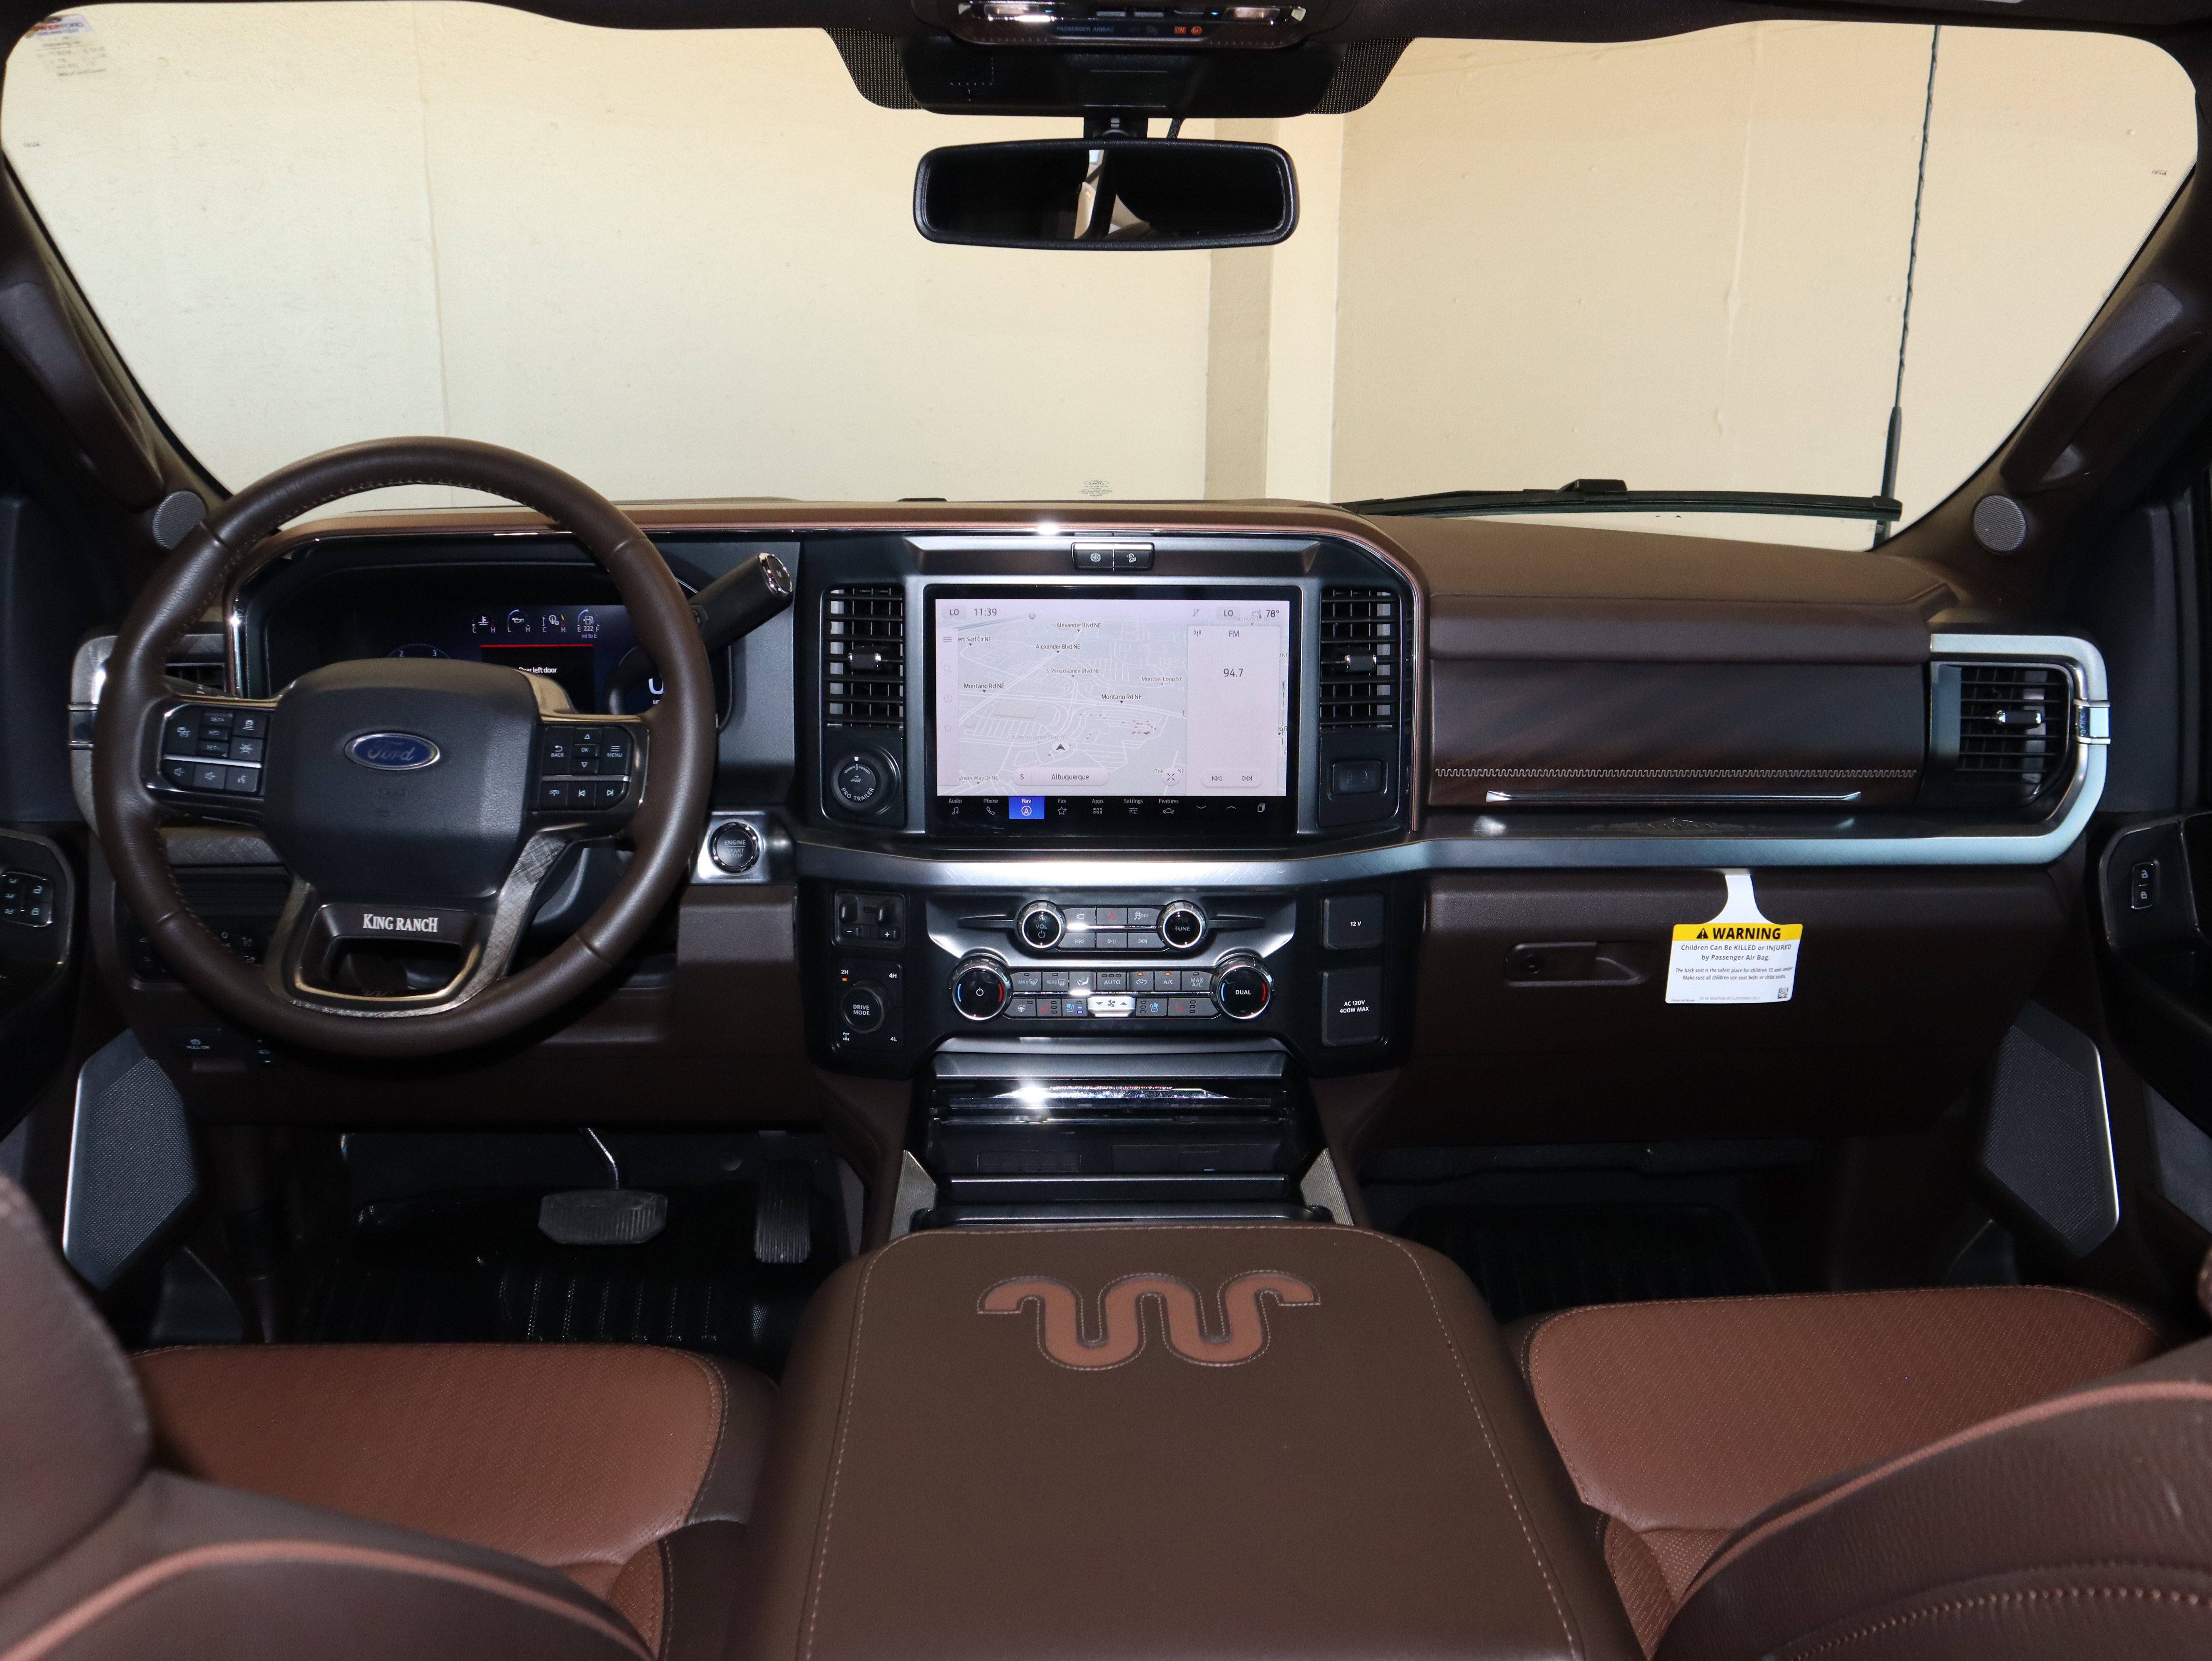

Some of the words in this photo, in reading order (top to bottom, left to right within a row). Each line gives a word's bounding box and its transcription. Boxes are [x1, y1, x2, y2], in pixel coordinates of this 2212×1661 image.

[1223, 669, 1243, 677] 94.7
[368, 740, 416, 761] Ford
[841, 787, 852, 799] PRO
[854, 787, 875, 801] TRAILER
[363, 914, 394, 930] KING
[396, 917, 438, 932] RANCH
[1713, 928, 1781, 939] WARNING
